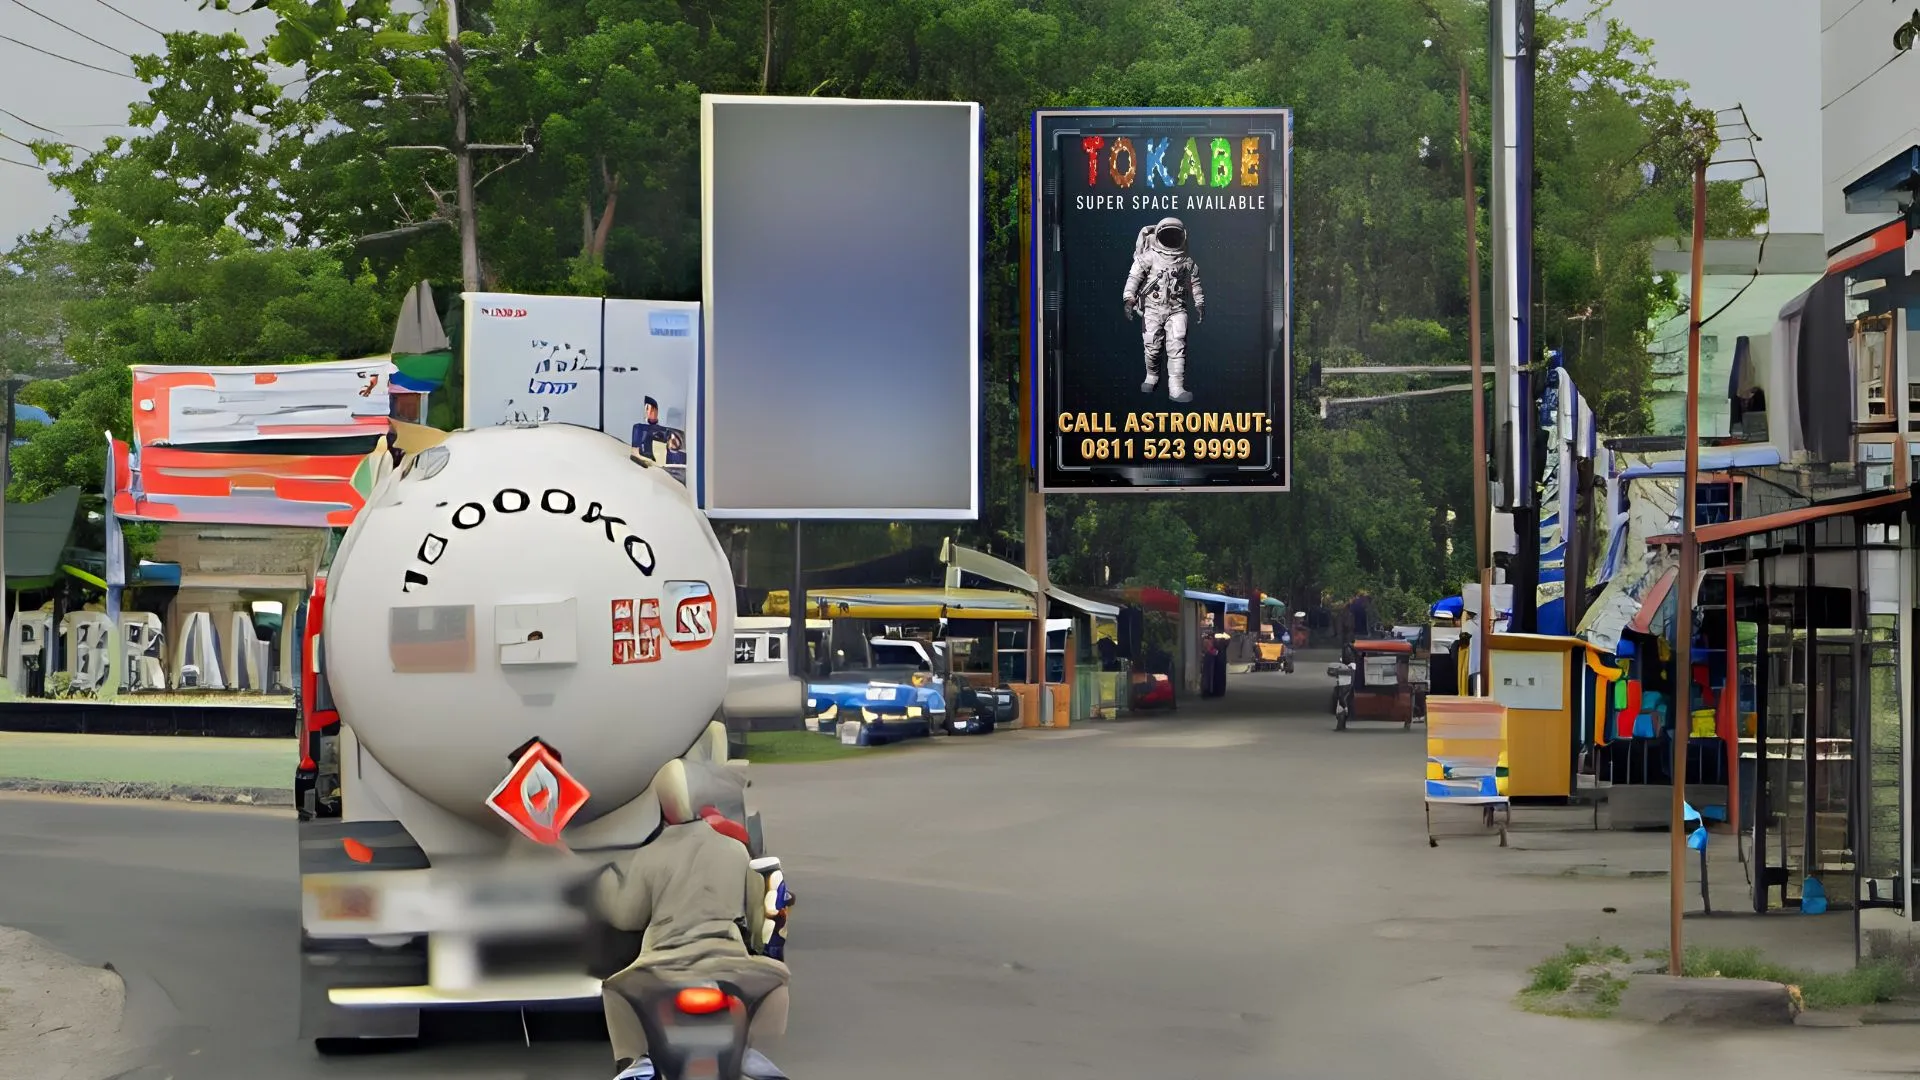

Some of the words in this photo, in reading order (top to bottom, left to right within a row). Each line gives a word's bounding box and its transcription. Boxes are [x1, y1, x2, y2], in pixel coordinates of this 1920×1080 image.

[1081, 136, 1260, 188] TOKABE
[1076, 195, 1124, 210] SUPER
[1132, 195, 1179, 210] SPACE
[1186, 195, 1266, 210] AVAILABLE
[1058, 412, 1117, 433] CALL
[1124, 412, 1273, 433] ASTRONAUT:
[1081, 438, 1134, 460] 0811
[1143, 438, 1186, 460] 523
[1193, 438, 1251, 460] 9999
